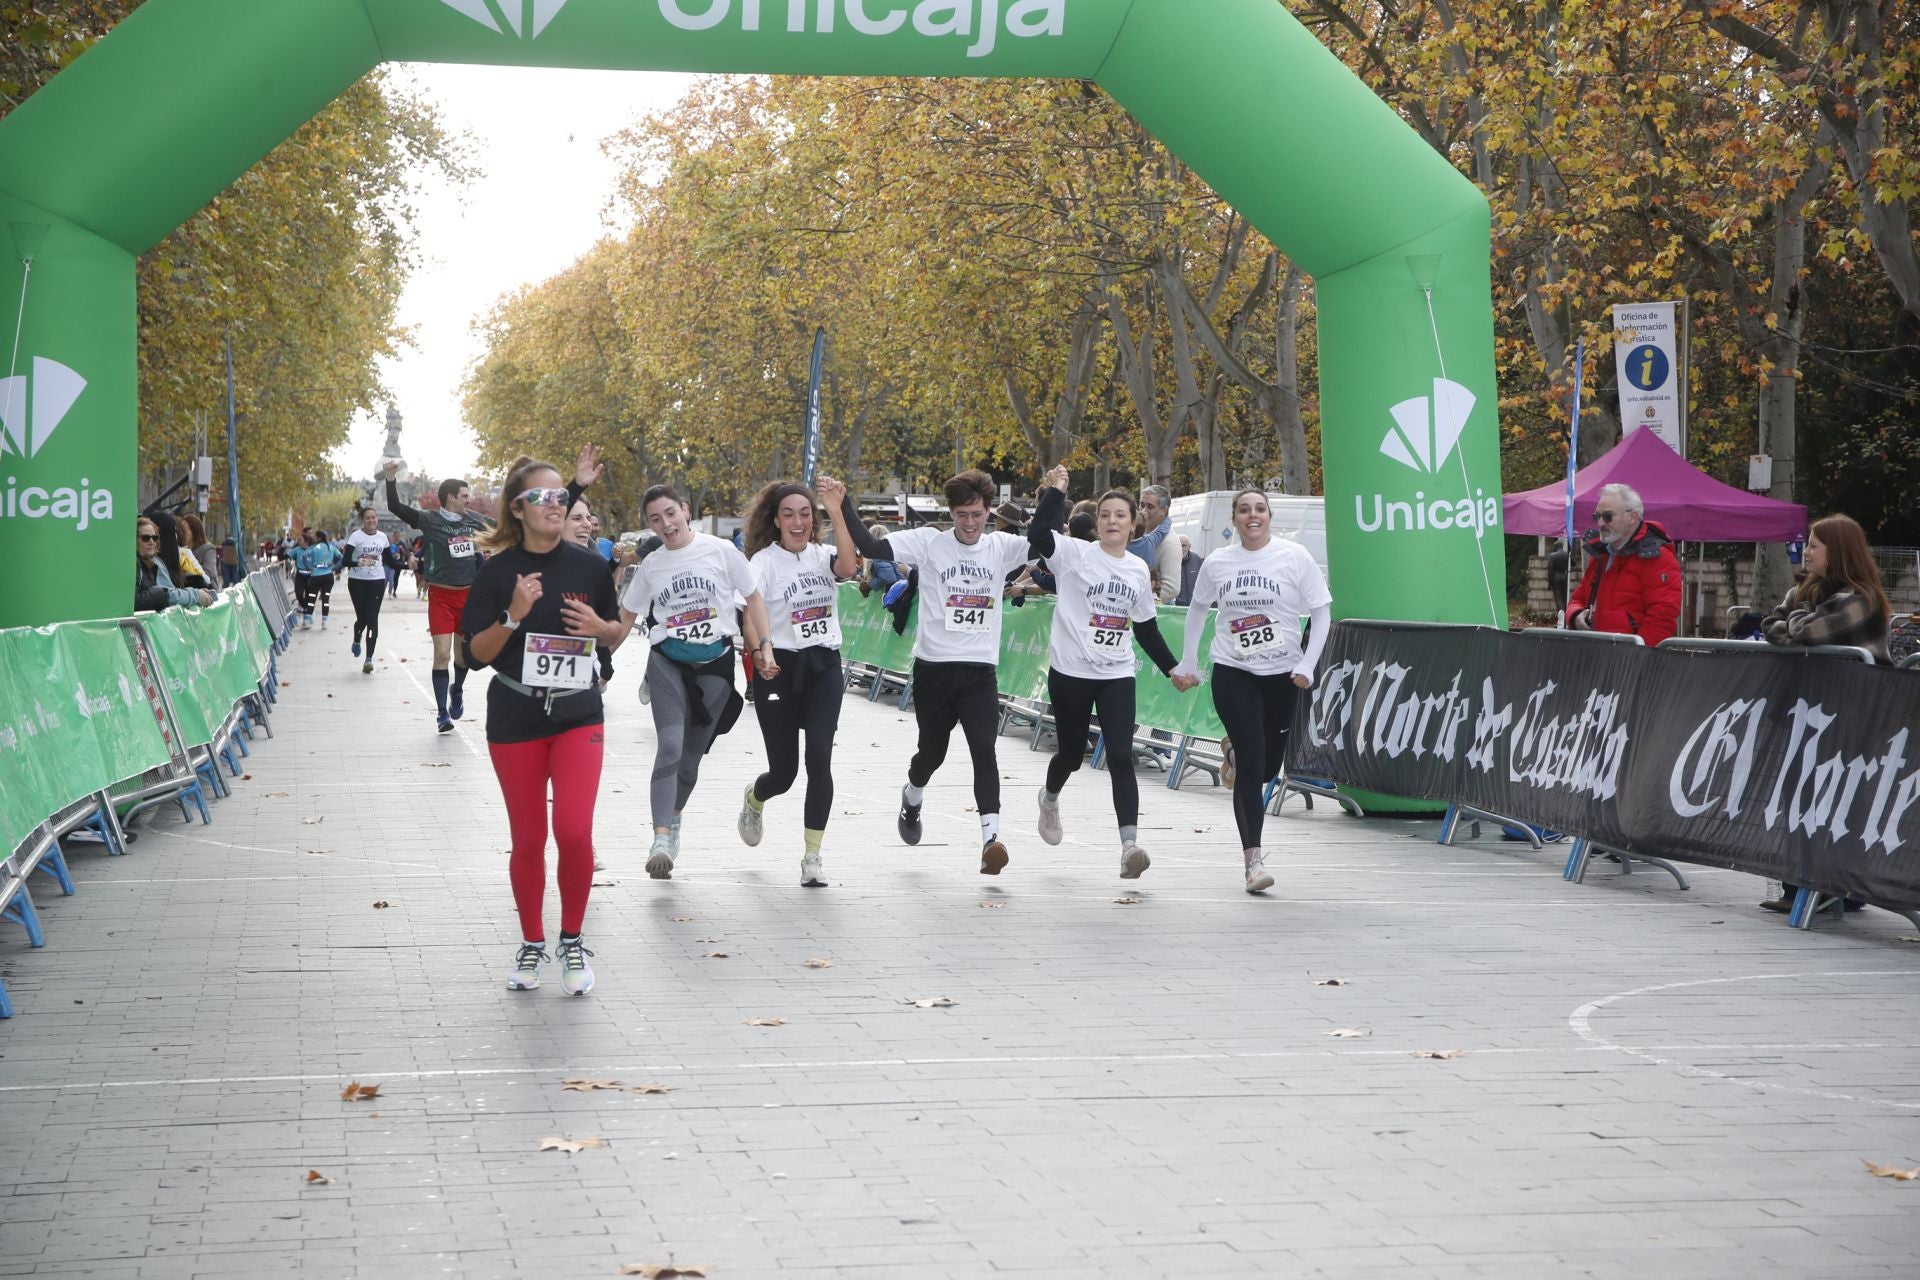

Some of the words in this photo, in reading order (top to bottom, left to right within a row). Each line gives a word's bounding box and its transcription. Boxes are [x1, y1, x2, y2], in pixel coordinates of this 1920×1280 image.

[1621, 313, 1647, 321] Oficina
[1649, 311, 1658, 319] de
[0, 476, 113, 531] icaja
[1355, 488, 1499, 539] Unicaja
[453, 543, 471, 554] 904
[1236, 575, 1281, 597] HORTEGA
[953, 609, 985, 625] 541
[676, 622, 713, 641] 542
[801, 620, 828, 639] 543
[1093, 630, 1123, 647] 527
[1240, 627, 1274, 648] 528
[536, 654, 576, 678] 971
[1357, 660, 1471, 763] Norte
[1465, 676, 1513, 774] de
[1669, 697, 1767, 821] El
[1764, 697, 1920, 856] Norte
